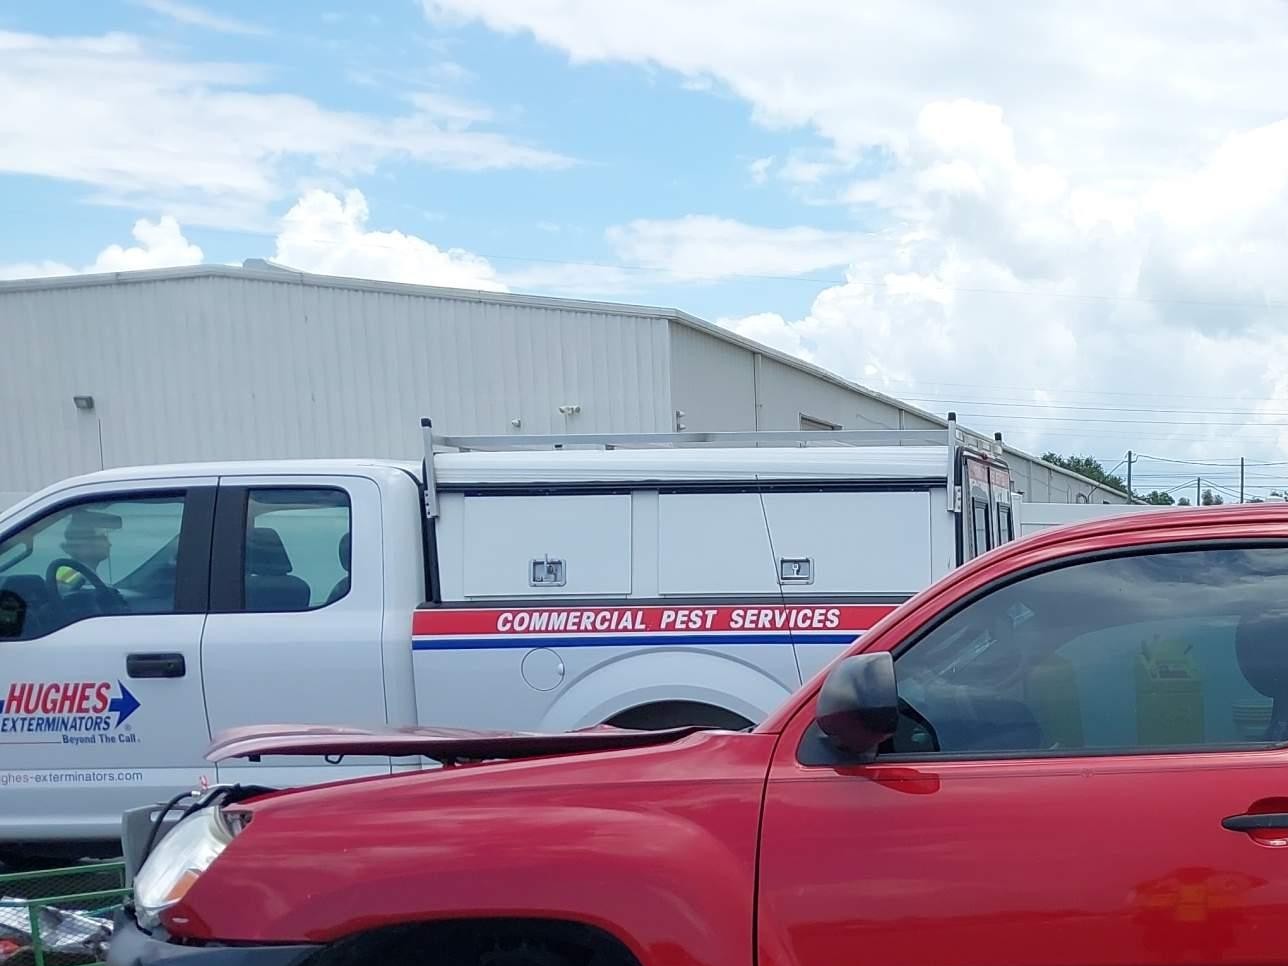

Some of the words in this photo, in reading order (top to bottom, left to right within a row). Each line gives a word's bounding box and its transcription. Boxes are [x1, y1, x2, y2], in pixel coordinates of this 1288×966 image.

[496, 609, 646, 632] COMMERCIAL
[660, 609, 718, 630] PEST
[729, 608, 841, 630] SERVICES
[4, 682, 112, 715] HUGHES
[1, 716, 112, 733] EXTERMINATORS
[62, 734, 96, 746] Beyond
[98, 734, 116, 744] The
